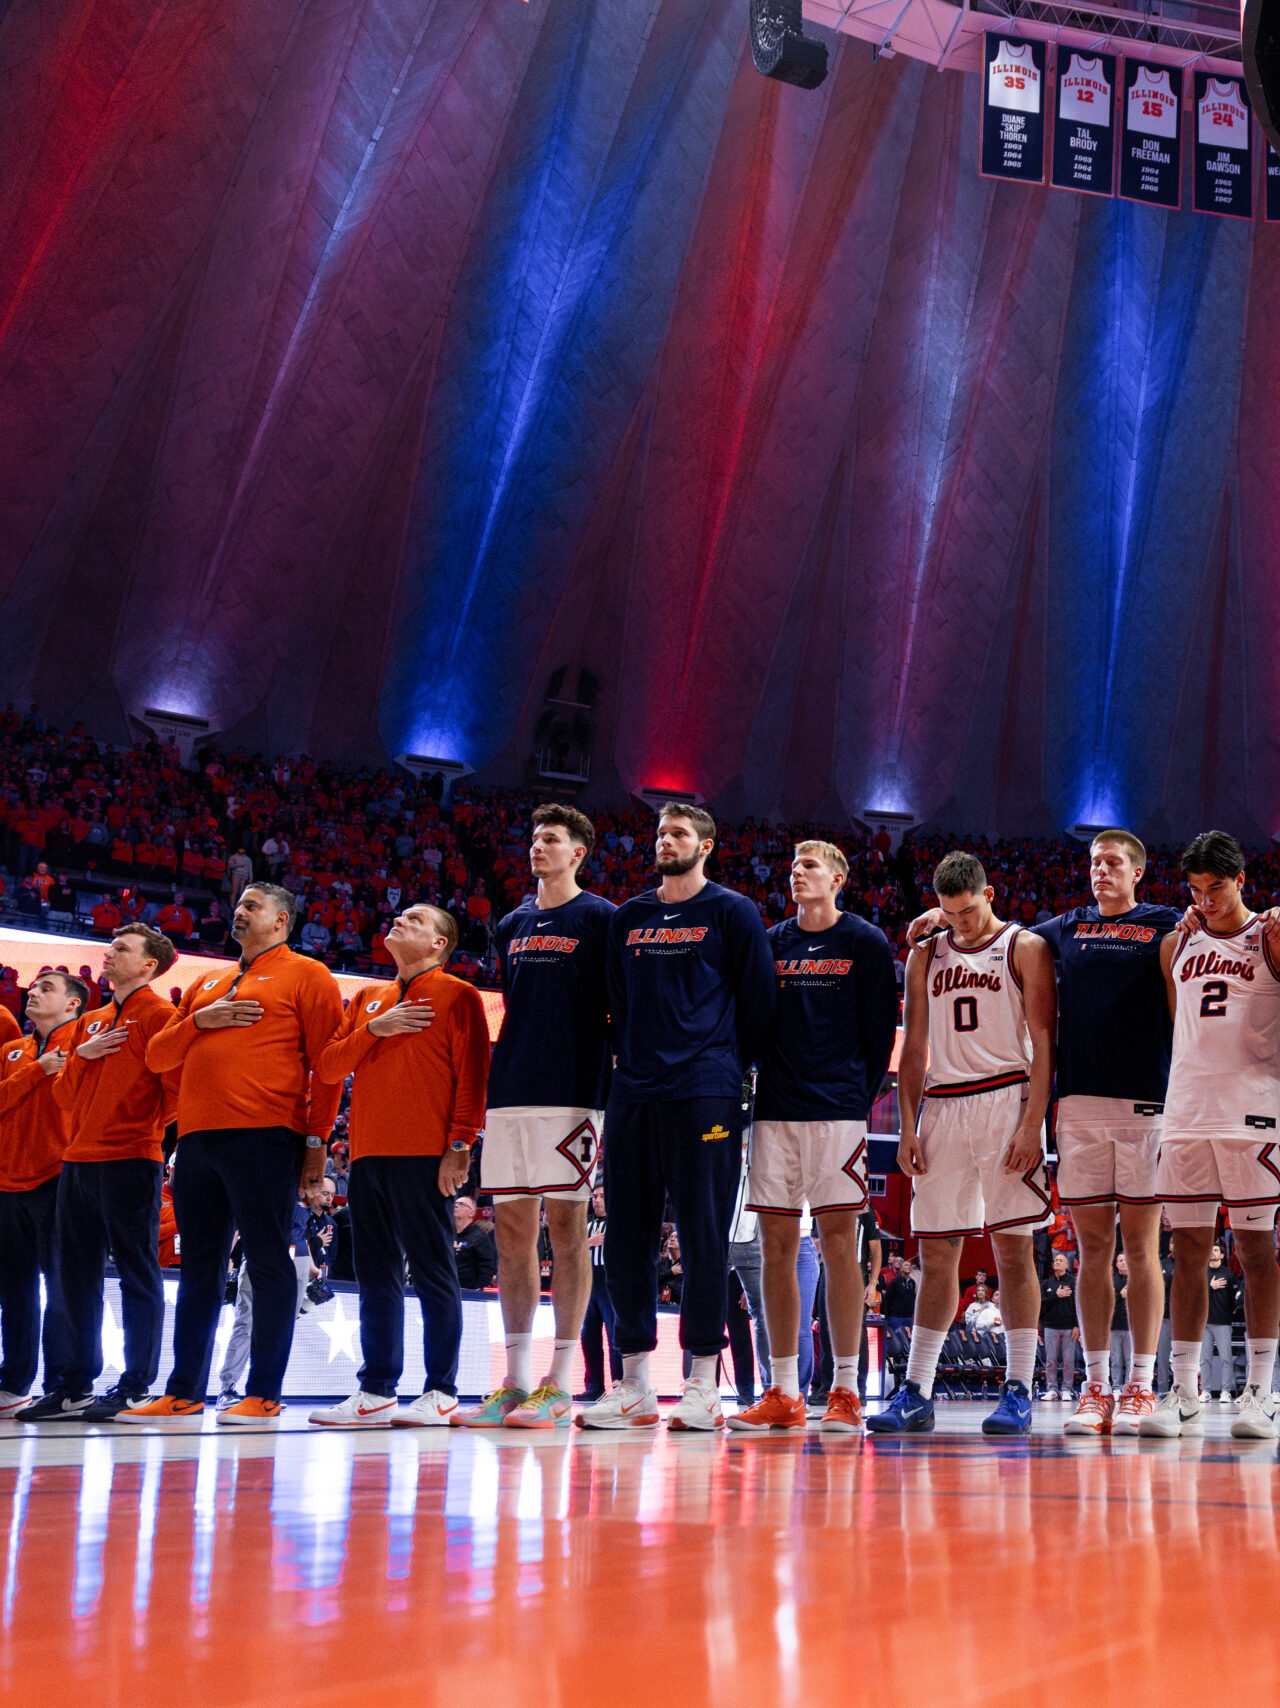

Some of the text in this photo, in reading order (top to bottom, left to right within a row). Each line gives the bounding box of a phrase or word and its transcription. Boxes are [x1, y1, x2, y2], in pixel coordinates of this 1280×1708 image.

[993, 64, 1038, 81] ILLINOIS
[1004, 76, 1025, 90] 35
[1064, 77, 1108, 95] ILLINOIS
[1077, 89, 1094, 103] 12
[1131, 91, 1175, 107] ILLINOIS
[1142, 101, 1163, 117] 15
[1202, 102, 1245, 120] ILLINOIS
[1002, 113, 1025, 124] DUANE
[1212, 112, 1233, 127] 24
[1000, 130, 1027, 143] THOREN
[1077, 127, 1092, 140] TAL
[1070, 137, 1098, 151] BRODY
[1142, 139, 1160, 151] DON
[1131, 147, 1171, 164] FREEMAN
[1216, 152, 1230, 163] JIM
[1206, 161, 1241, 175] DAWSON
[625, 927, 709, 946] ILLINOIS
[1073, 923, 1157, 943] ILLINOIS
[507, 936, 580, 955] ILLINOIS
[774, 959, 854, 975] ILLINOIS
[1180, 950, 1256, 983] Illinois
[932, 964, 1002, 998] Illinois
[1200, 981, 1229, 1017] 2
[954, 996, 979, 1033] 0
